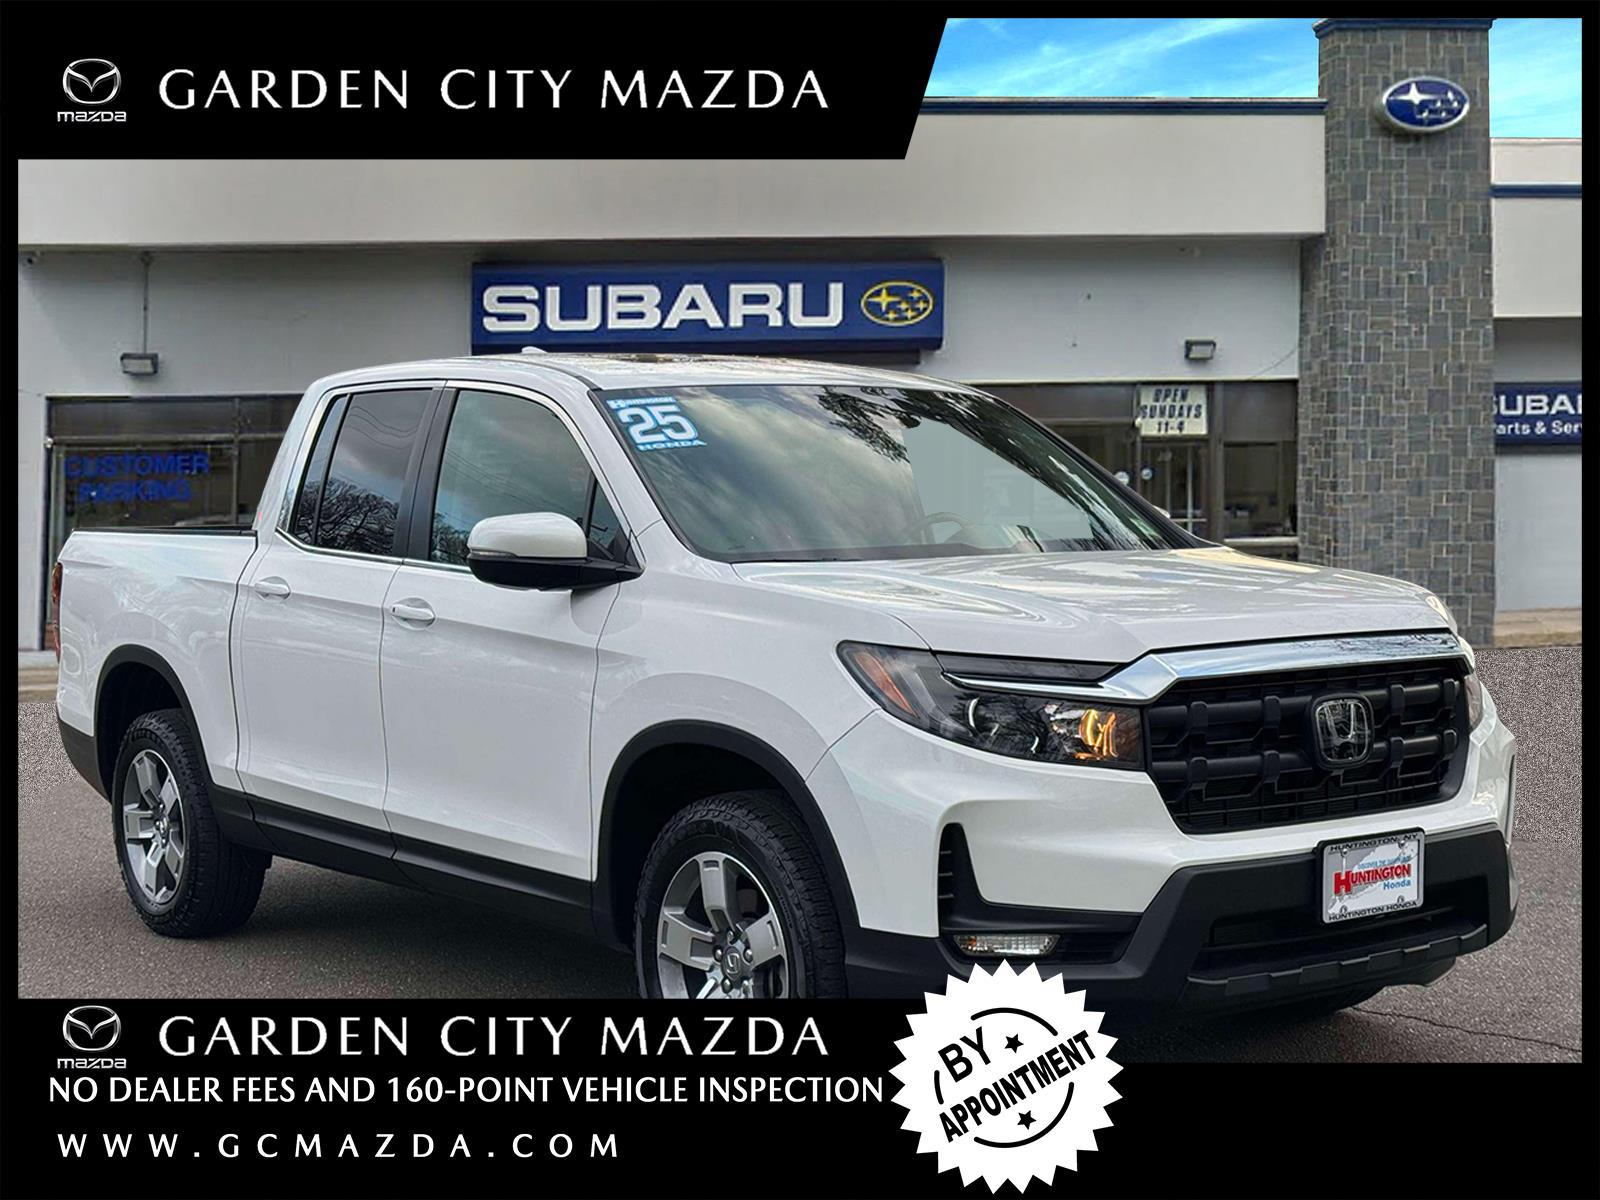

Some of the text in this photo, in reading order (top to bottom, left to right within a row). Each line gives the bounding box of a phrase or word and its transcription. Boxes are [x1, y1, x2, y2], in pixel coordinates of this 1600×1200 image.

[483, 282, 843, 332] SUBARU
[1153, 388, 1189, 402] OPEN
[1493, 394, 1582, 415] UBA
[1140, 404, 1202, 419] SUNDAYS
[617, 404, 699, 445] 25
[1534, 421, 1546, 435] &
[1551, 420, 1582, 435] Ser
[65, 453, 209, 477] CUSTOMER
[79, 479, 191, 502] PARKING
[1383, 880, 1412, 891] Honda
[1328, 900, 1418, 921] HUNTINGTON HONDA
